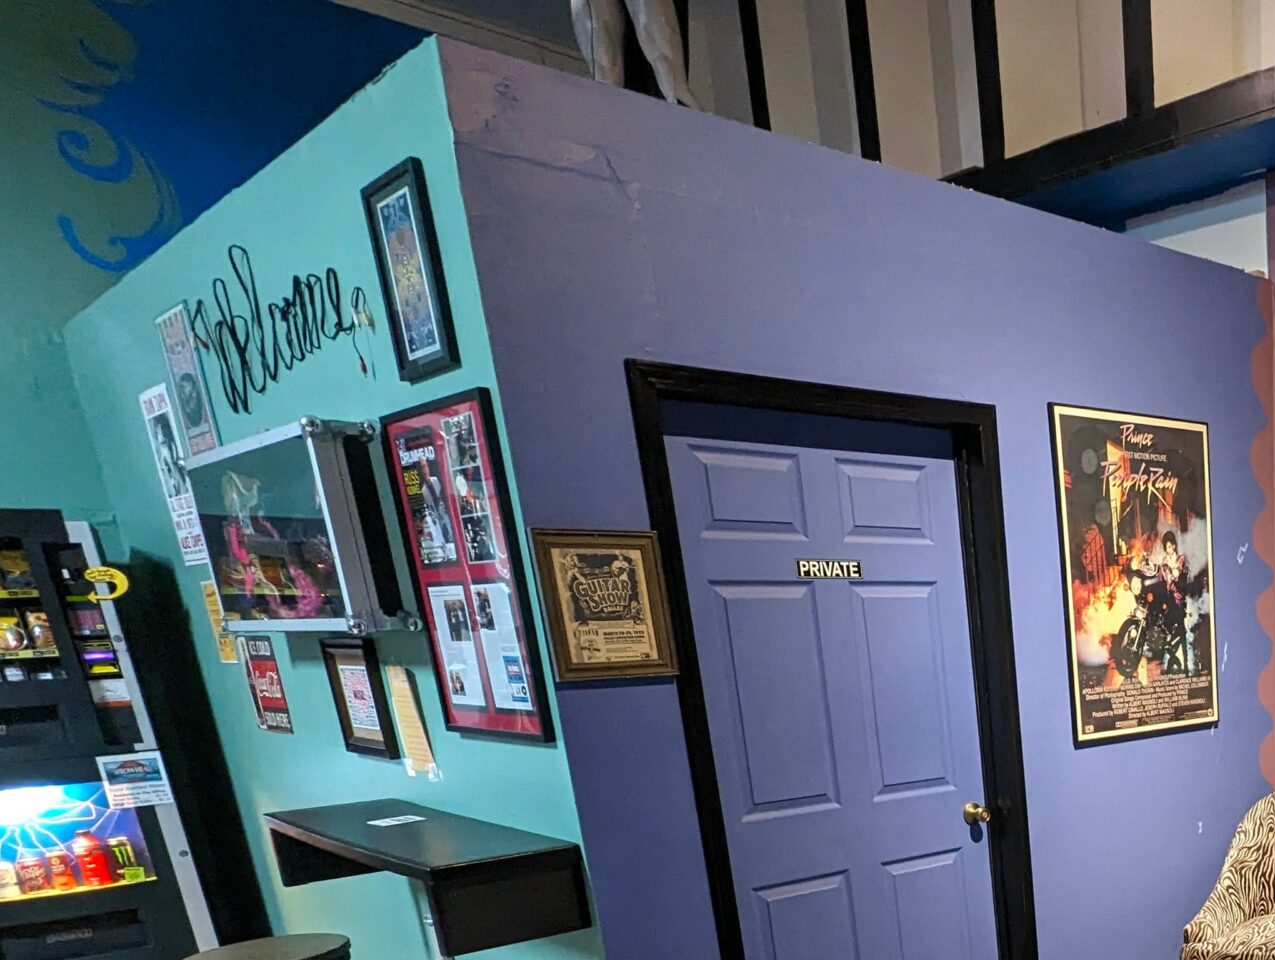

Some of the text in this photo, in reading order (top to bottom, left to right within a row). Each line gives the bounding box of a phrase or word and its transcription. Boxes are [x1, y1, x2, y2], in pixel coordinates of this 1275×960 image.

[1120, 424, 1154, 449] Prince
[1100, 461, 1178, 512] Purple Rain
[799, 560, 860, 578] PRIVATE
[573, 578, 631, 600] GUITAR
[588, 591, 629, 612] SHOW
[248, 640, 257, 656] ICE
[256, 640, 271, 656] COLD
